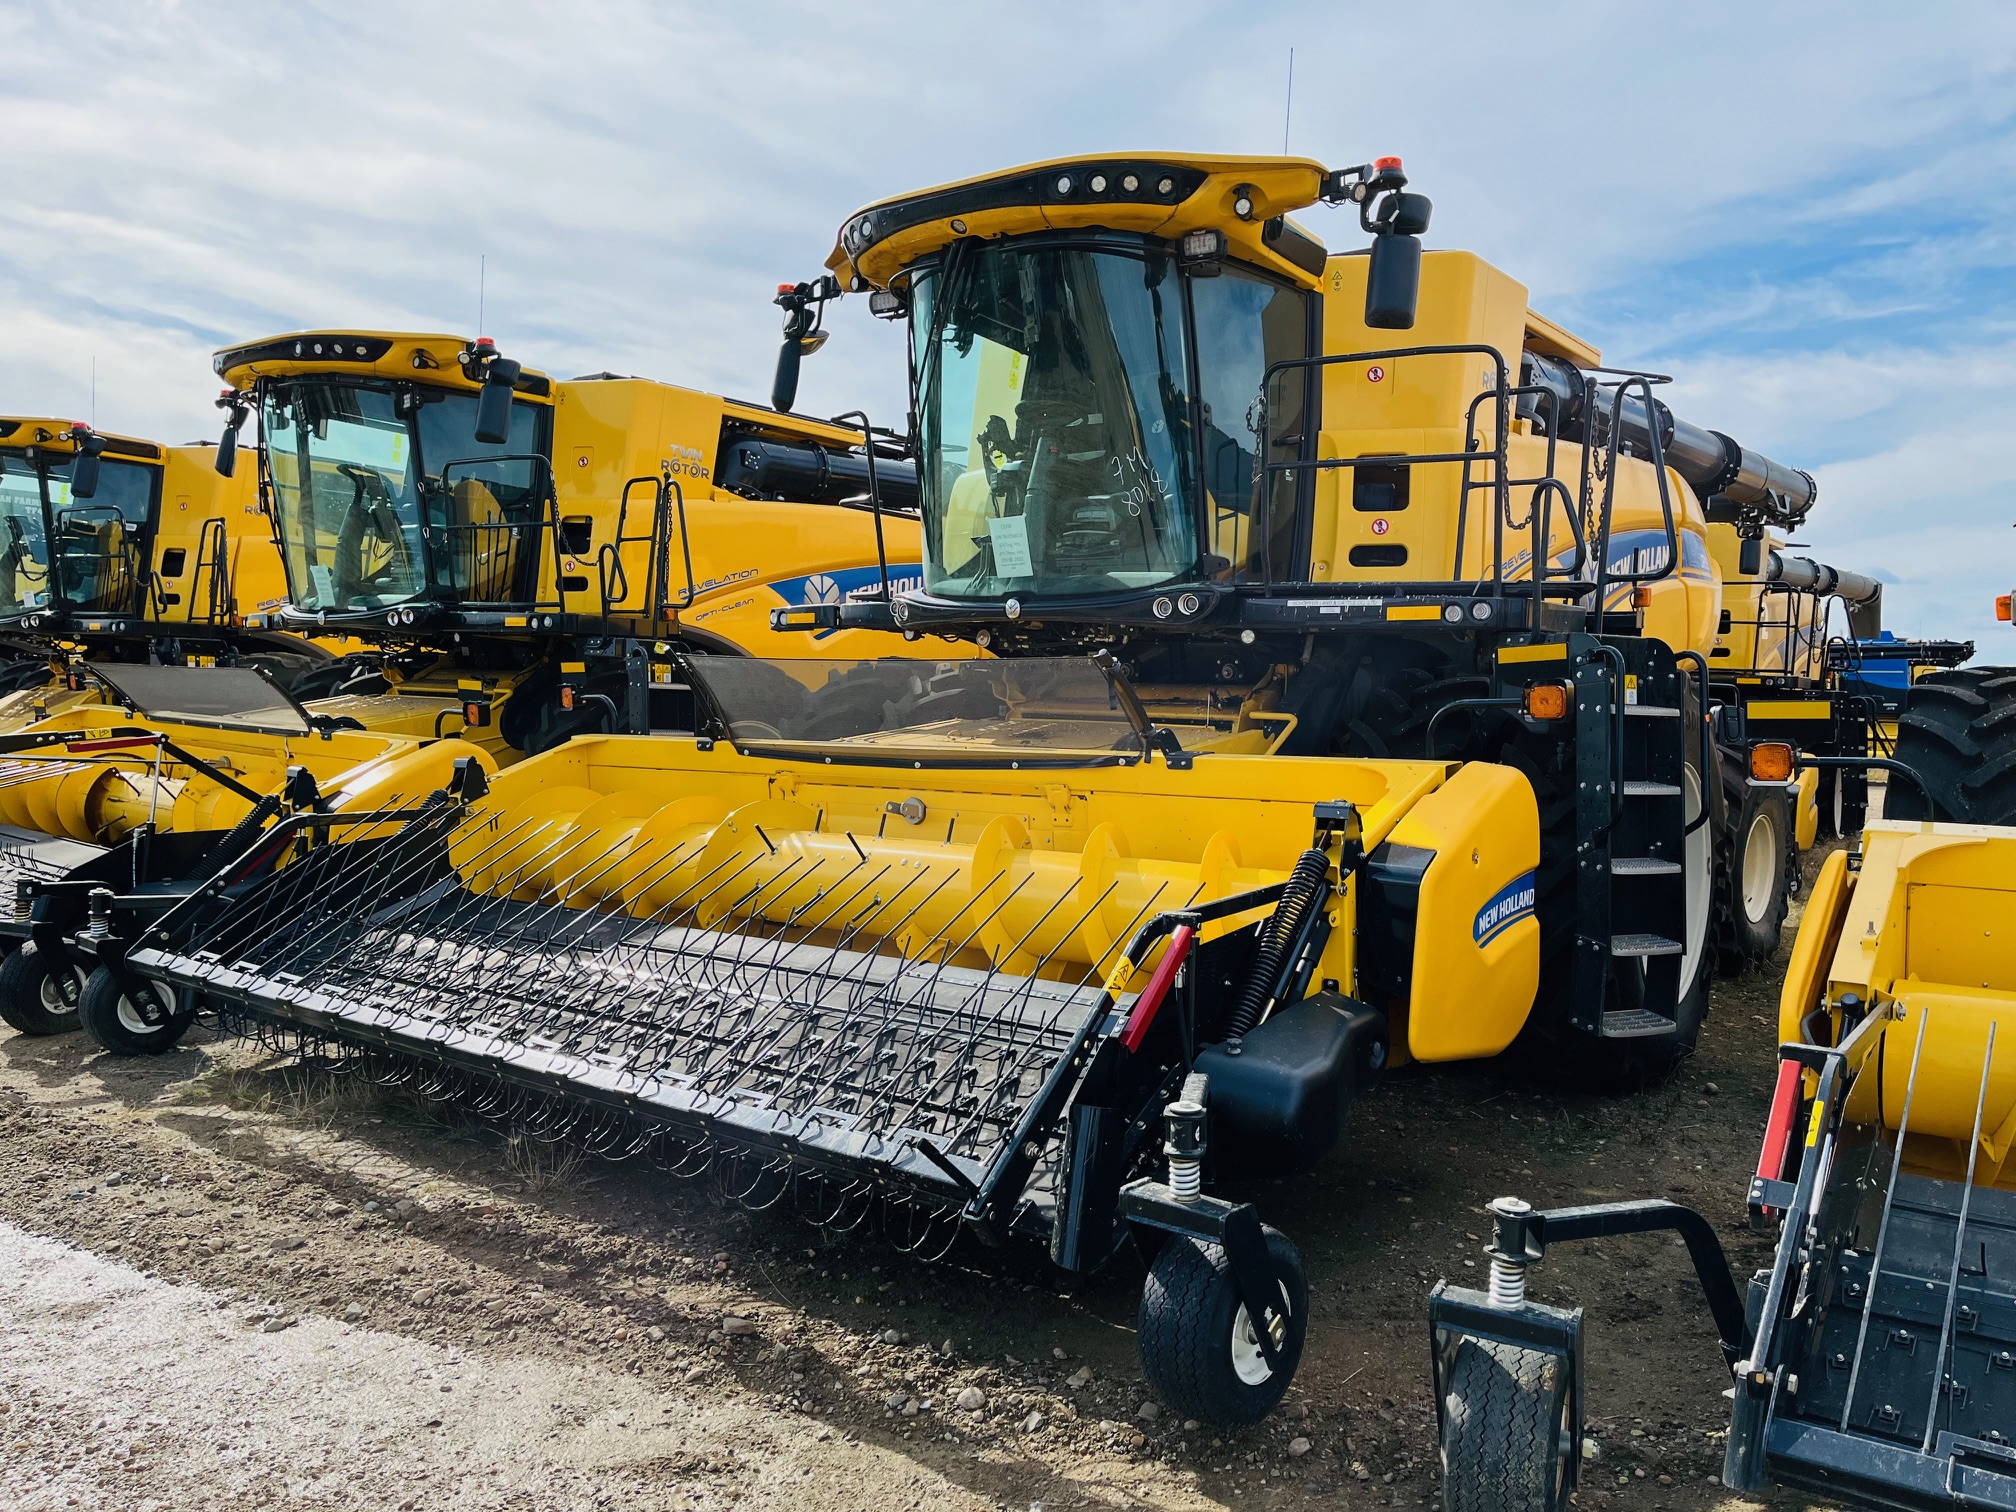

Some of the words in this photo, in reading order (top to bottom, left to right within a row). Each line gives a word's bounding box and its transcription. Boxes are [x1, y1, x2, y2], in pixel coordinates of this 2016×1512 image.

[670, 444, 703, 462] TWIN
[1632, 546, 1670, 574] OLLAN
[678, 569, 759, 597] REVELATION
[1479, 904, 1498, 935] NEW
[1499, 888, 1535, 919] HOLLAND
